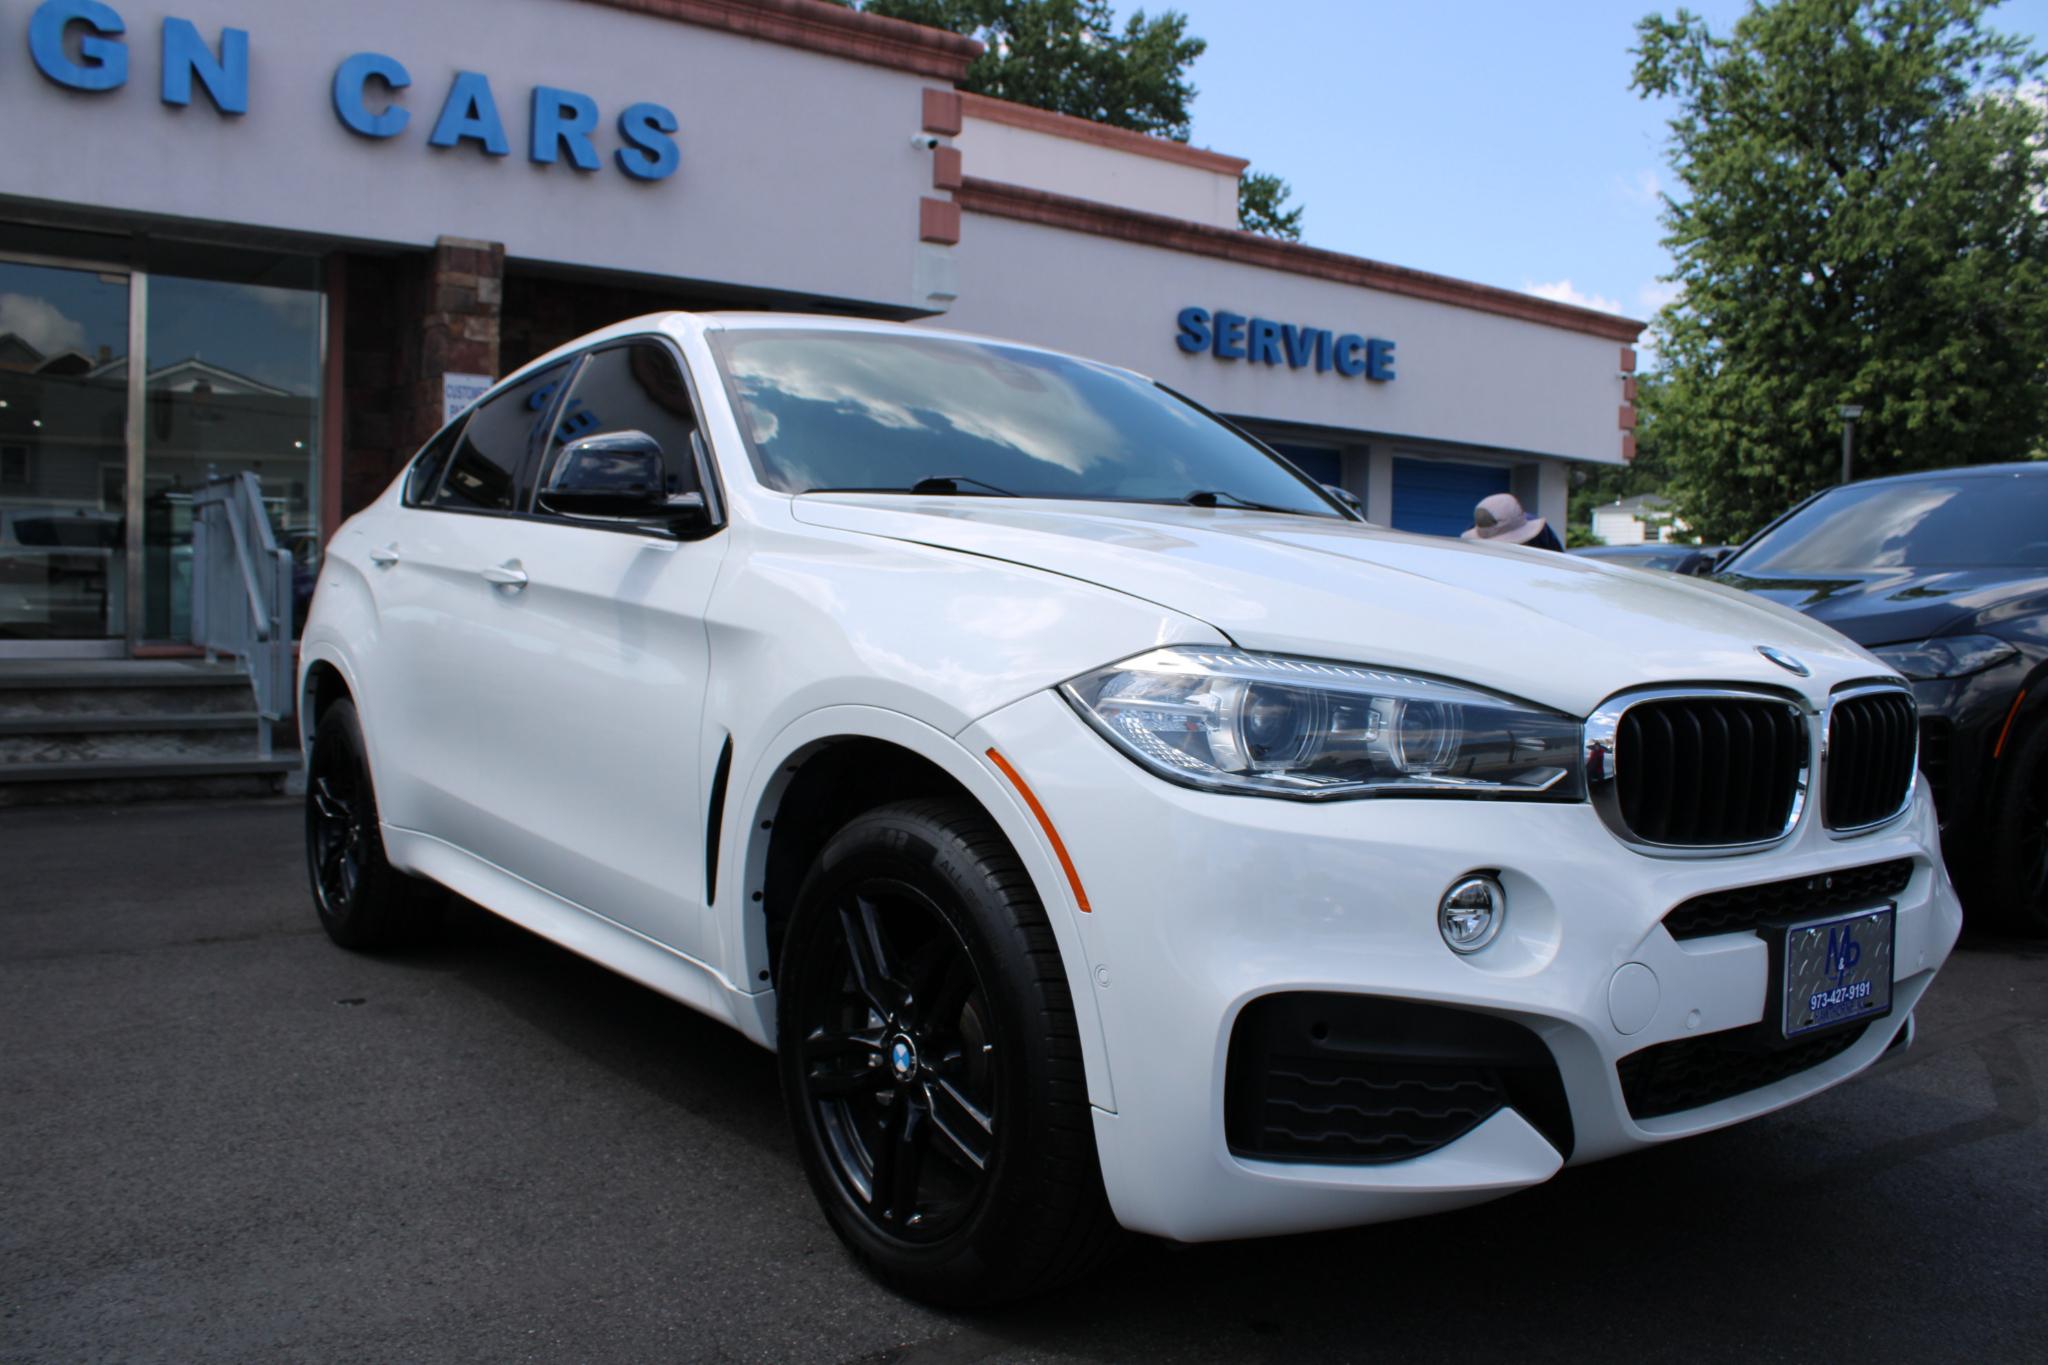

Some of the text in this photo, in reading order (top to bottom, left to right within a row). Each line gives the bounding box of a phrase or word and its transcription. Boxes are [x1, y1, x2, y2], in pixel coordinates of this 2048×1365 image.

[28, 0, 681, 181] GN CARS
[1176, 307, 1396, 382] SERVICE
[1810, 981, 1871, 1010] 973-427-9191
